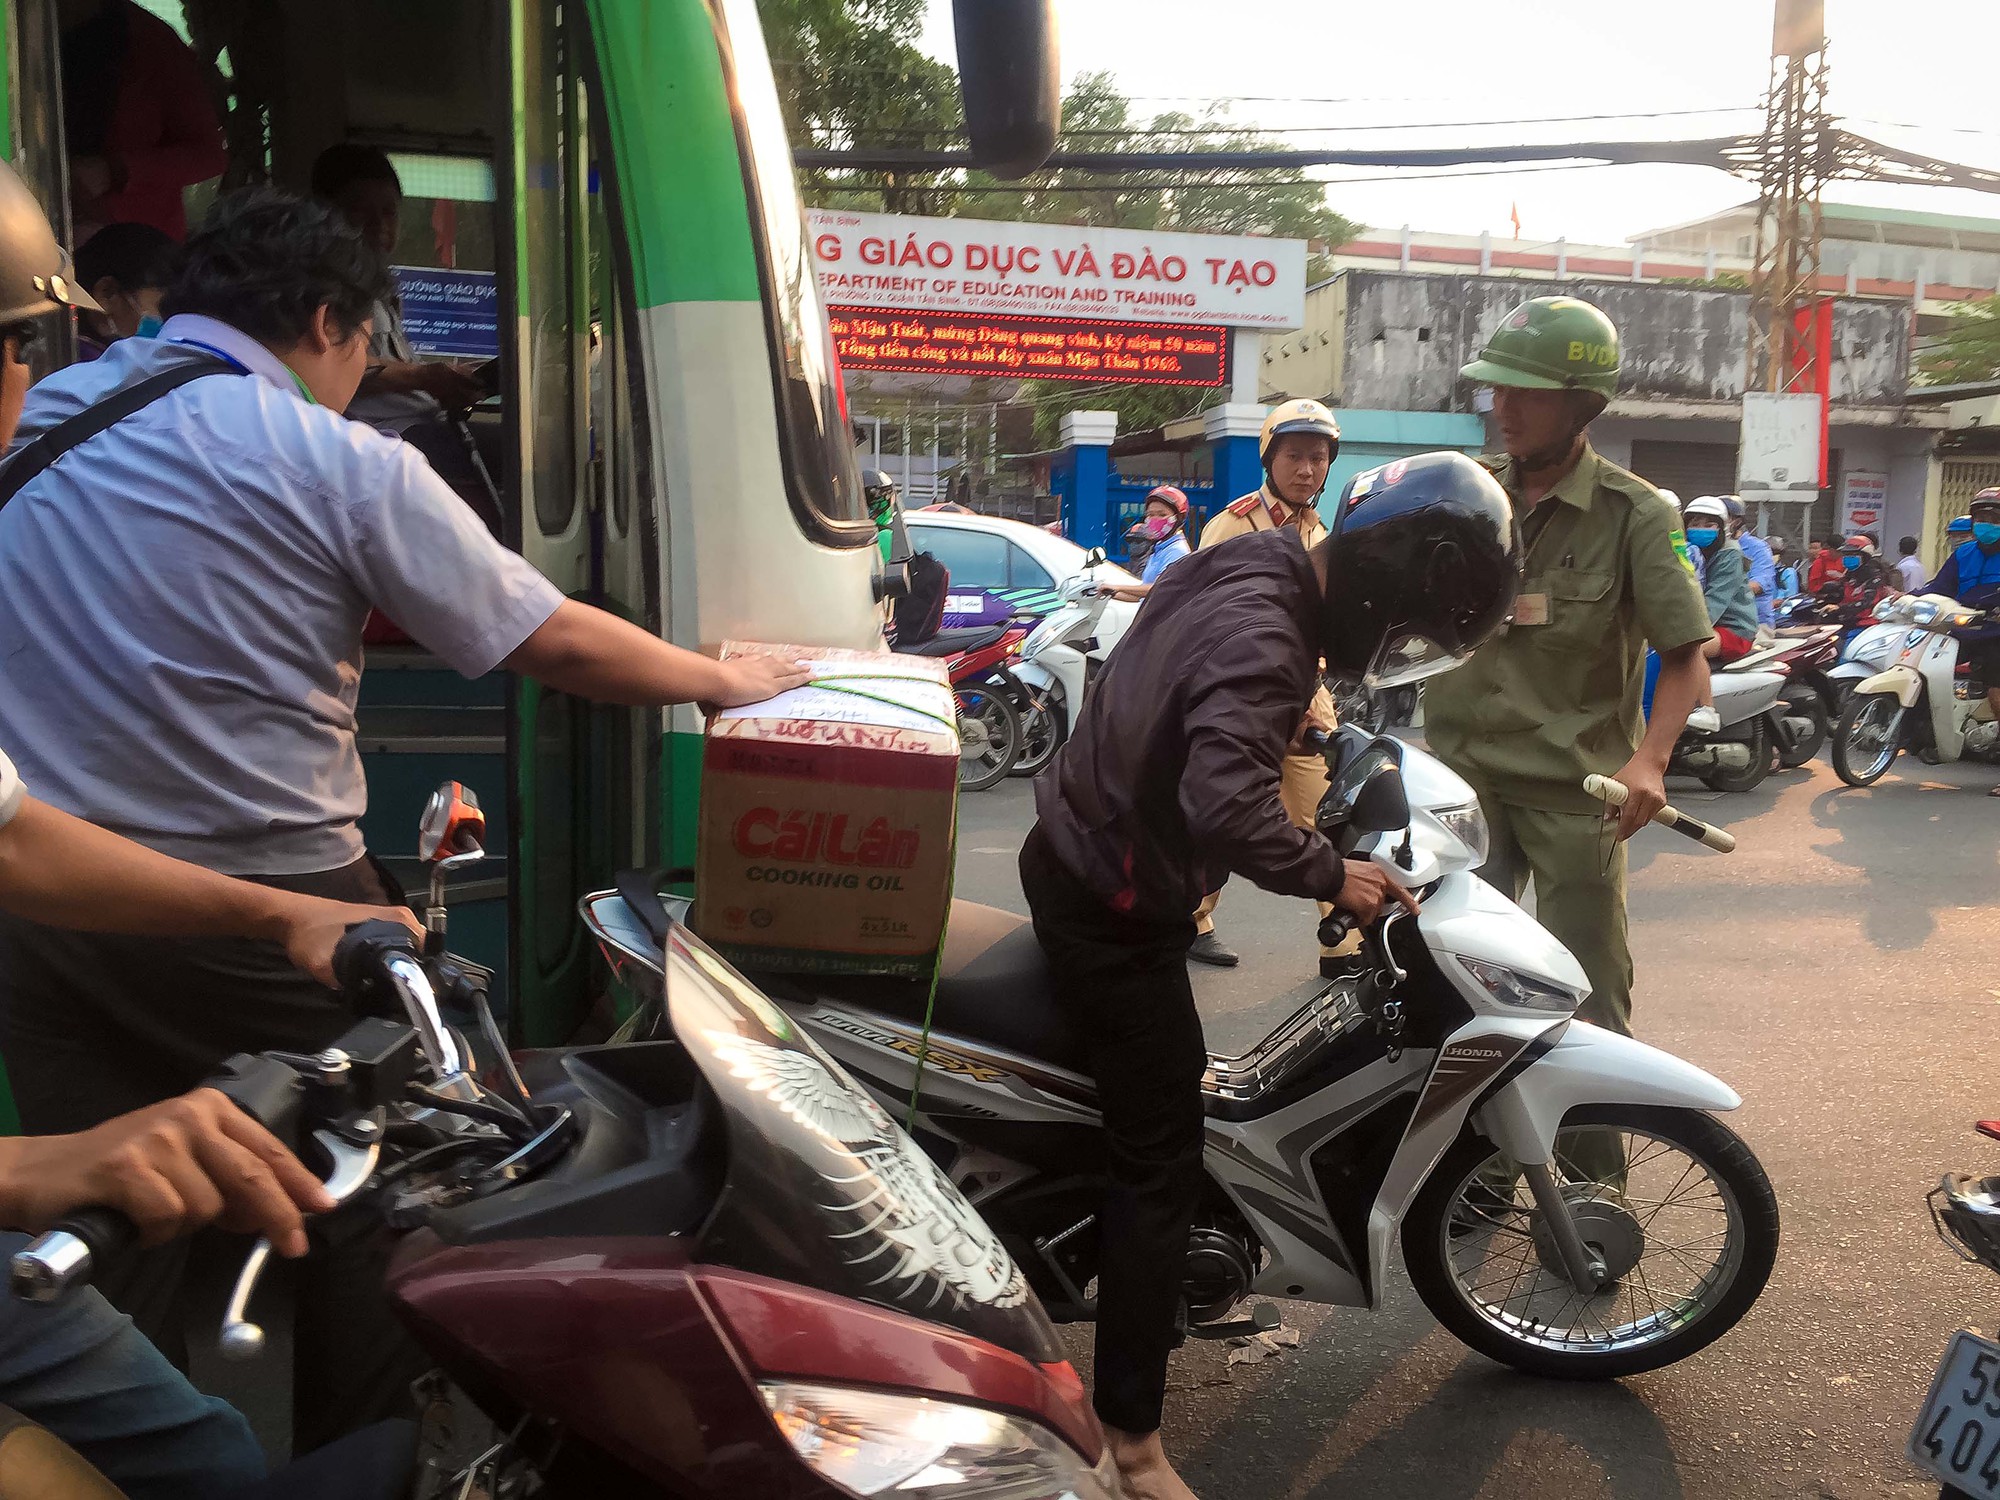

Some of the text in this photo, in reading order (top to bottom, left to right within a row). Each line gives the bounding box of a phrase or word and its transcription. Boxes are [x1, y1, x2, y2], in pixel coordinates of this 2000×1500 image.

[860, 232, 953, 268] GIÁO
[965, 244, 1041, 279] DỤC
[1053, 242, 1101, 277] VÀ
[1110, 246, 1188, 282] ĐÀO
[1204, 258, 1277, 294] TẠO
[933, 278, 957, 295] OF
[963, 281, 1066, 299] EDUCATION
[1071, 287, 1108, 302] AND
[1114, 290, 1197, 307] TRAINING
[745, 866, 905, 891] COOKING OIL
[1450, 1047, 1503, 1058] HONDA
